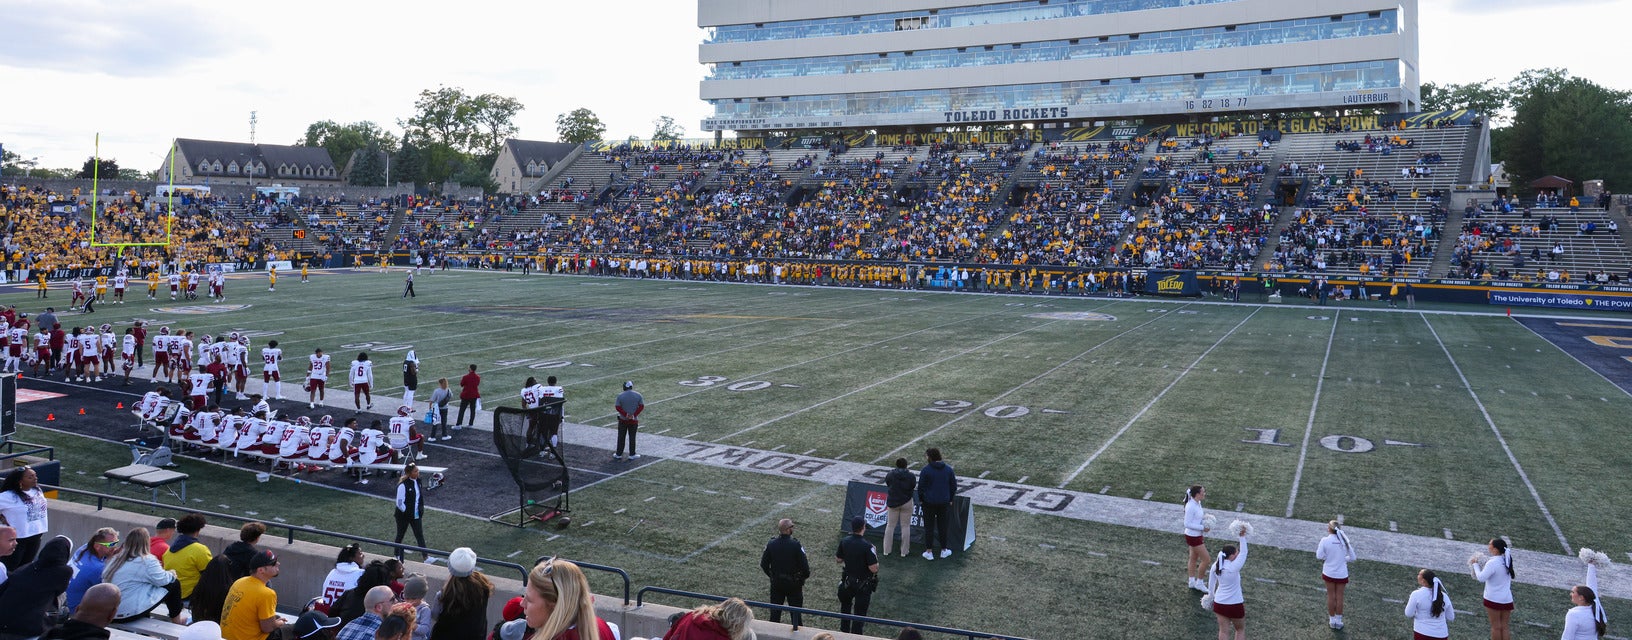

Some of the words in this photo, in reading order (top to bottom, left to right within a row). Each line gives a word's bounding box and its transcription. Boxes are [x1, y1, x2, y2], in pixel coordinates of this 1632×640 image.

[1185, 100, 1195, 110] 16
[1202, 99, 1213, 109] 82
[1220, 98, 1230, 108] 18
[1237, 97, 1248, 107] 77
[1343, 92, 1389, 104] LAUTERBUR
[944, 109, 997, 122] TOLEDO
[1002, 107, 1068, 120] ROCKETS
[1111, 128, 1138, 136] MAC
[1240, 121, 1258, 135] TO
[294, 230, 305, 238] 40
[1156, 281, 1184, 292] TOLEDO
[1508, 295, 1546, 305] University
[1557, 298, 1584, 306] Toledo
[70, 340, 79, 349] 18
[84, 340, 91, 350] 5
[157, 340, 163, 349] 9
[170, 340, 179, 350] 26
[265, 354, 275, 364] 24
[313, 361, 323, 370] 23
[357, 366, 364, 377] 6
[196, 379, 203, 388] 7
[677, 374, 774, 393] 30
[523, 392, 536, 405] 53
[915, 398, 1032, 420] 20
[392, 423, 402, 434] 10
[310, 432, 322, 447] 52
[1240, 426, 1377, 454] 10
[676, 442, 837, 477] BOWL
[865, 513, 887, 521] COLLEGE
[324, 587, 345, 605] 55
